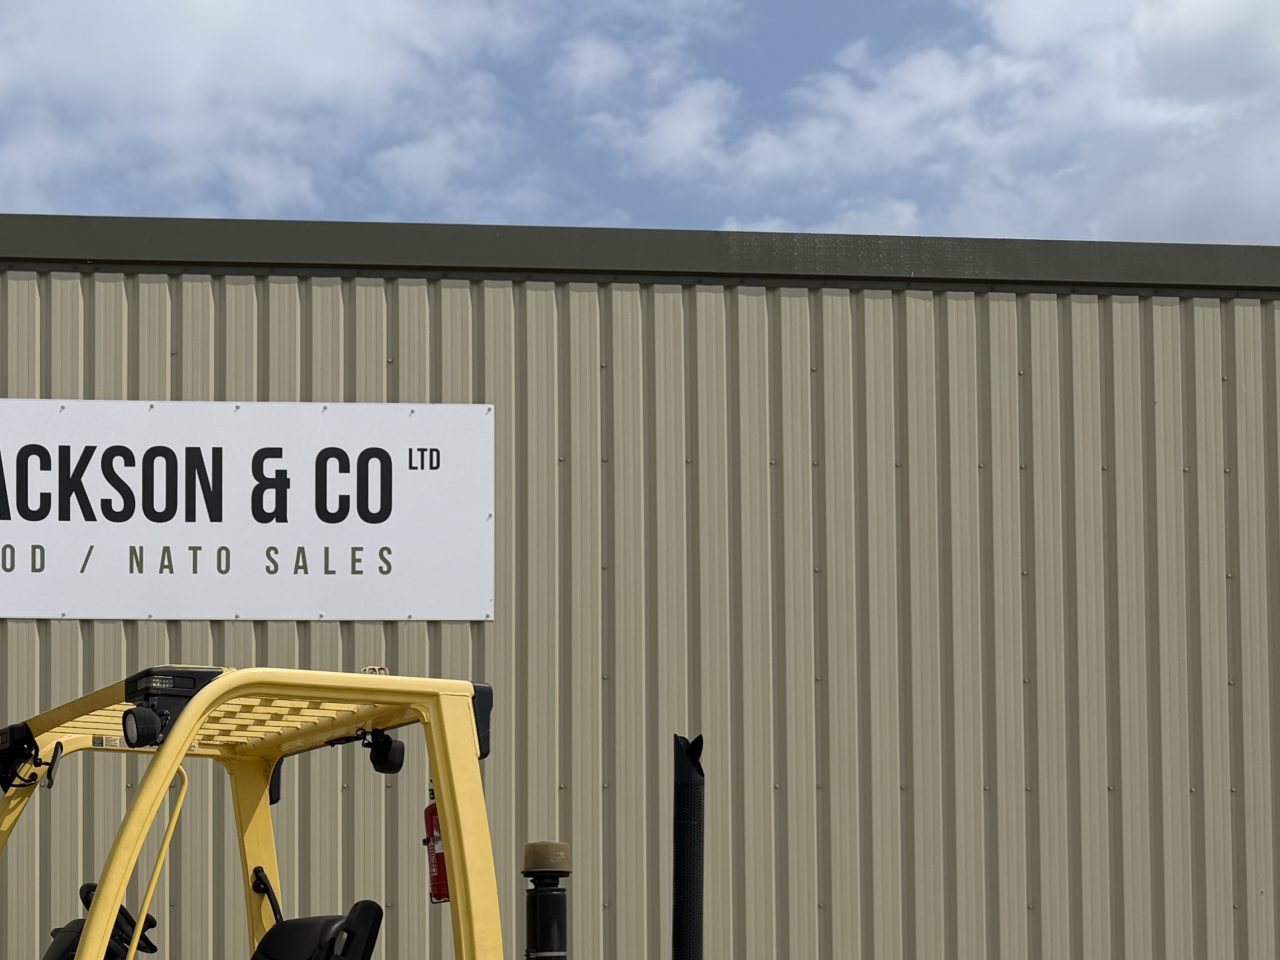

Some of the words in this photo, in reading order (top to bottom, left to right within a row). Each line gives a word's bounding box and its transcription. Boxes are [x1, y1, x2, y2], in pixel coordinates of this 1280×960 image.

[250, 446, 292, 524] &
[314, 446, 394, 525] CO
[408, 447, 442, 471] LTD
[79, 544, 96, 574] /
[129, 545, 232, 575] NATO
[265, 545, 394, 576] SALES
